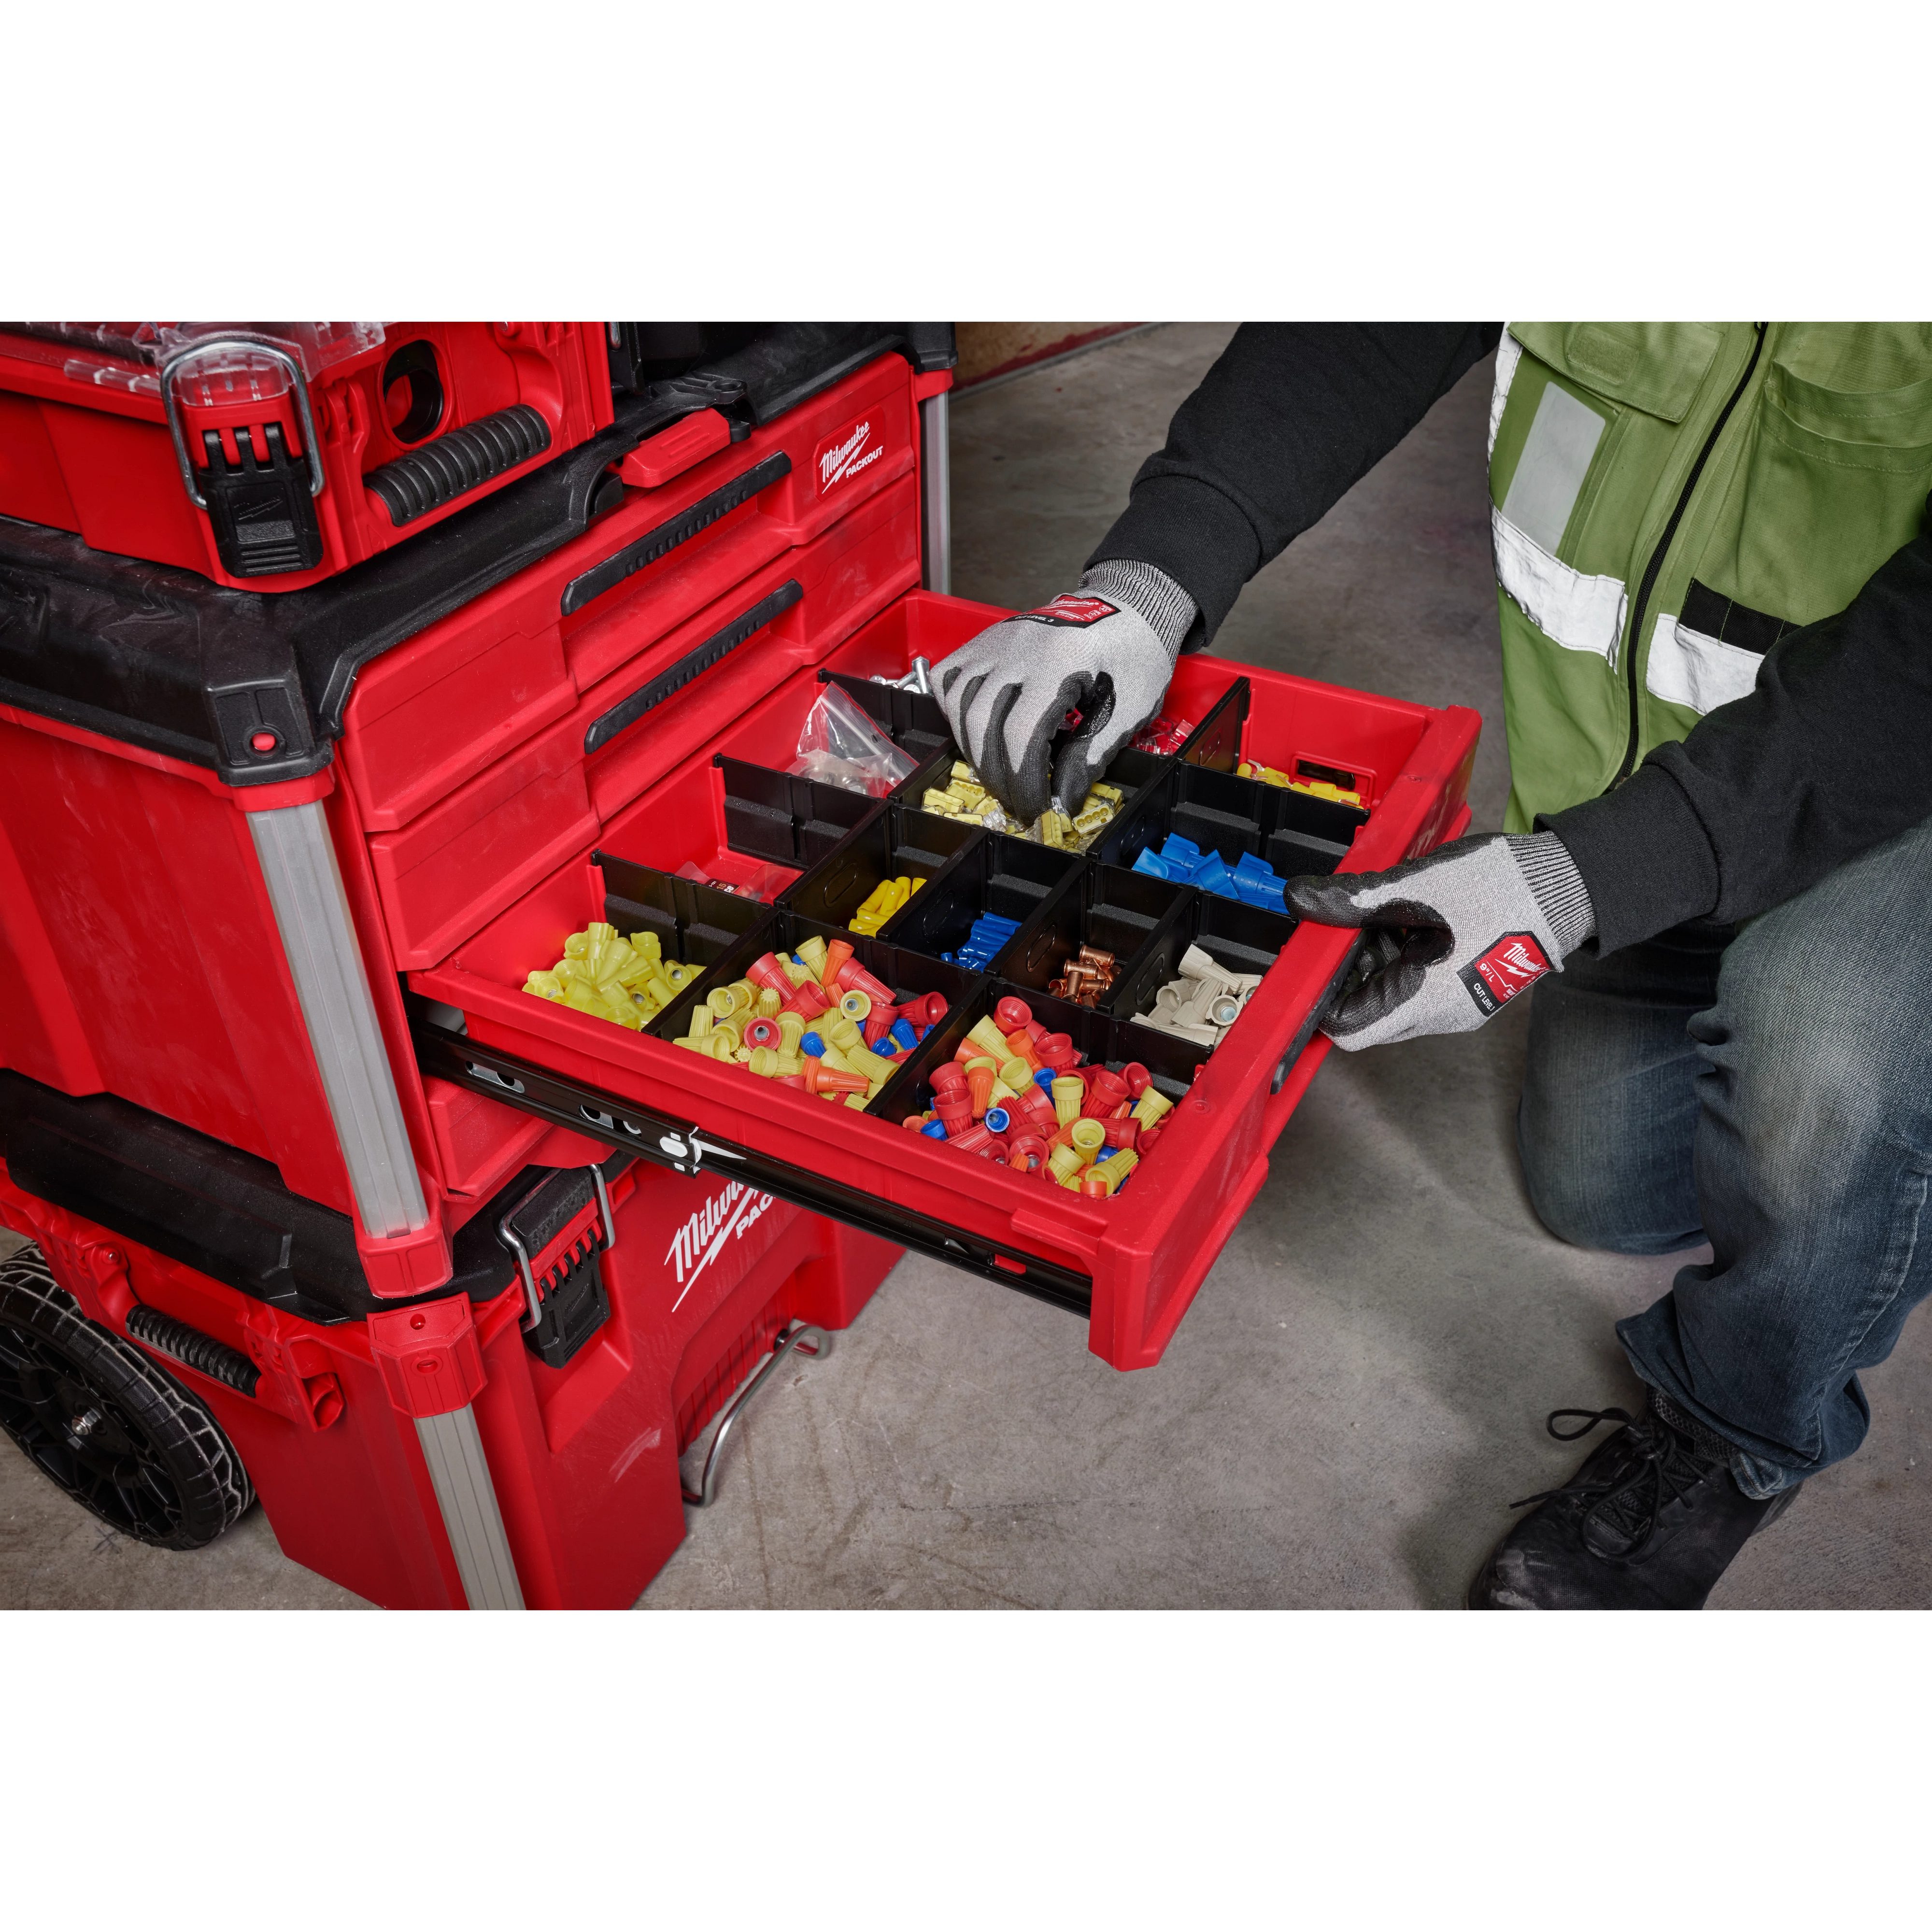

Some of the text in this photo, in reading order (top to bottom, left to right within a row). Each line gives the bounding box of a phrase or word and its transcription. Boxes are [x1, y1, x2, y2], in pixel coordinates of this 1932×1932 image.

[819, 422, 869, 483] Milwaukee
[846, 445, 883, 478] PACKOUT
[1474, 983, 1486, 997] CUT
[1481, 996, 1493, 1010] LEVEL
